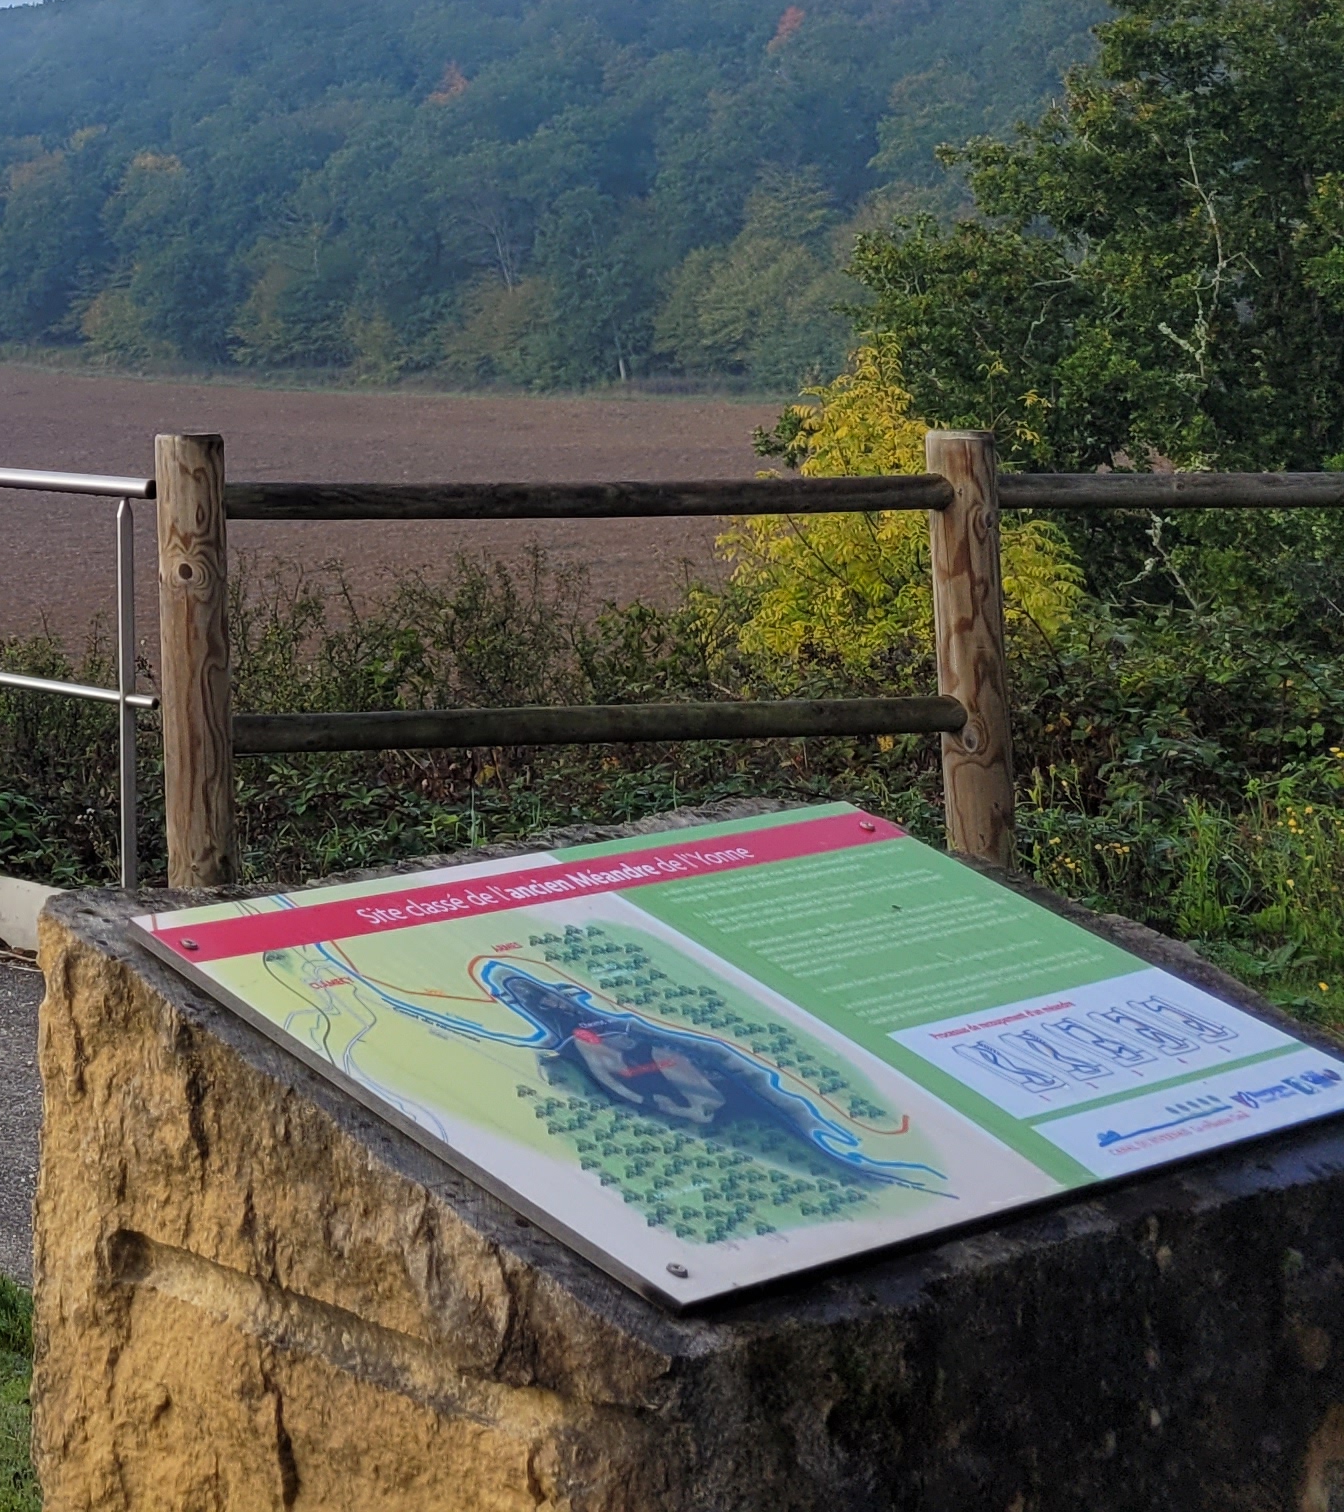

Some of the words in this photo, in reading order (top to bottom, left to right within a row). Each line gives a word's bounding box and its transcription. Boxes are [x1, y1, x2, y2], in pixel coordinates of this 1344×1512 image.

[356, 907, 408, 925] Site
[405, 893, 470, 918] classé
[465, 889, 499, 907] de
[486, 878, 576, 901] l'ancien
[565, 862, 661, 889] Méandre
[653, 856, 687, 873] de
[674, 846, 754, 869] l'Yonne
